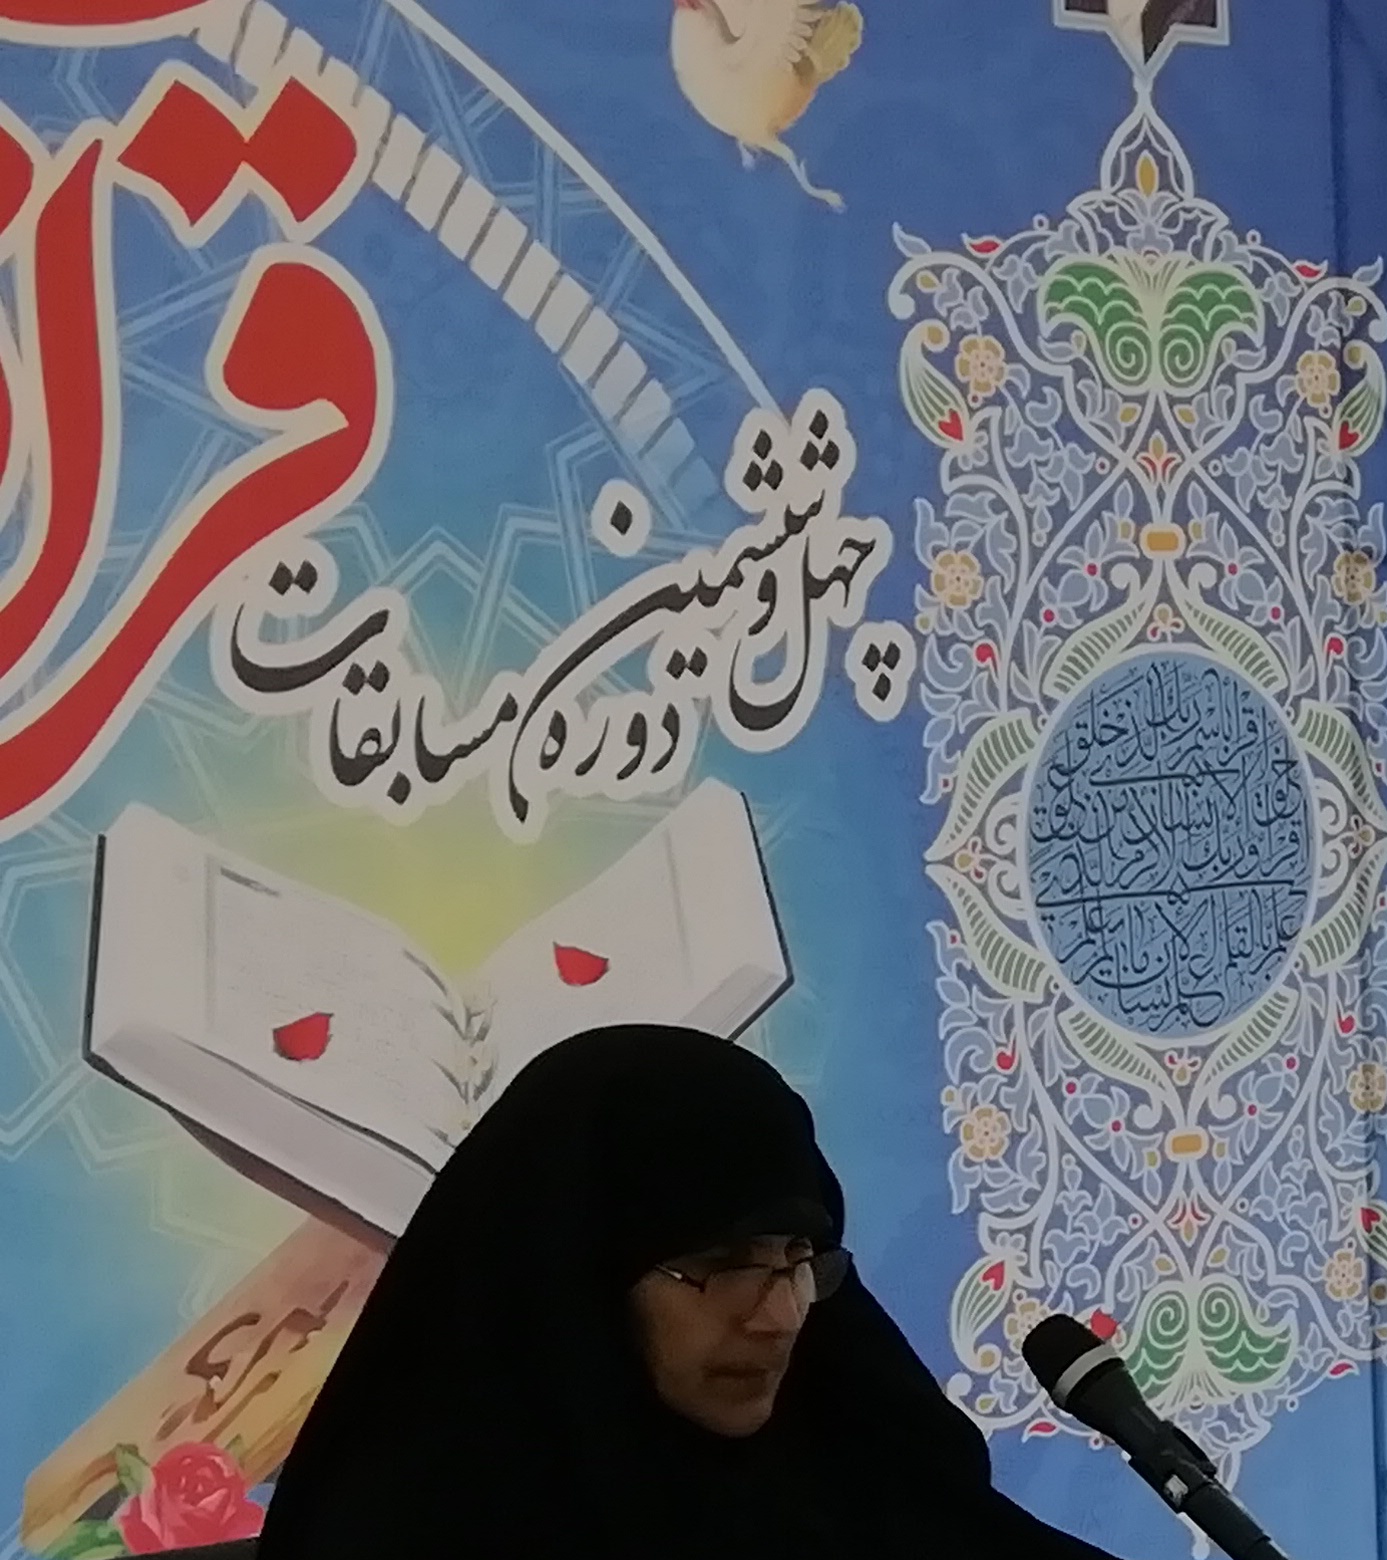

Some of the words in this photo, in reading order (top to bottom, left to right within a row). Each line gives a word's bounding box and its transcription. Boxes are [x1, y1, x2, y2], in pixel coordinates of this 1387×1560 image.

[230, 559, 519, 806] مسابقات
[730, 533, 902, 734] چهل
[539, 699, 681, 781] دوره
